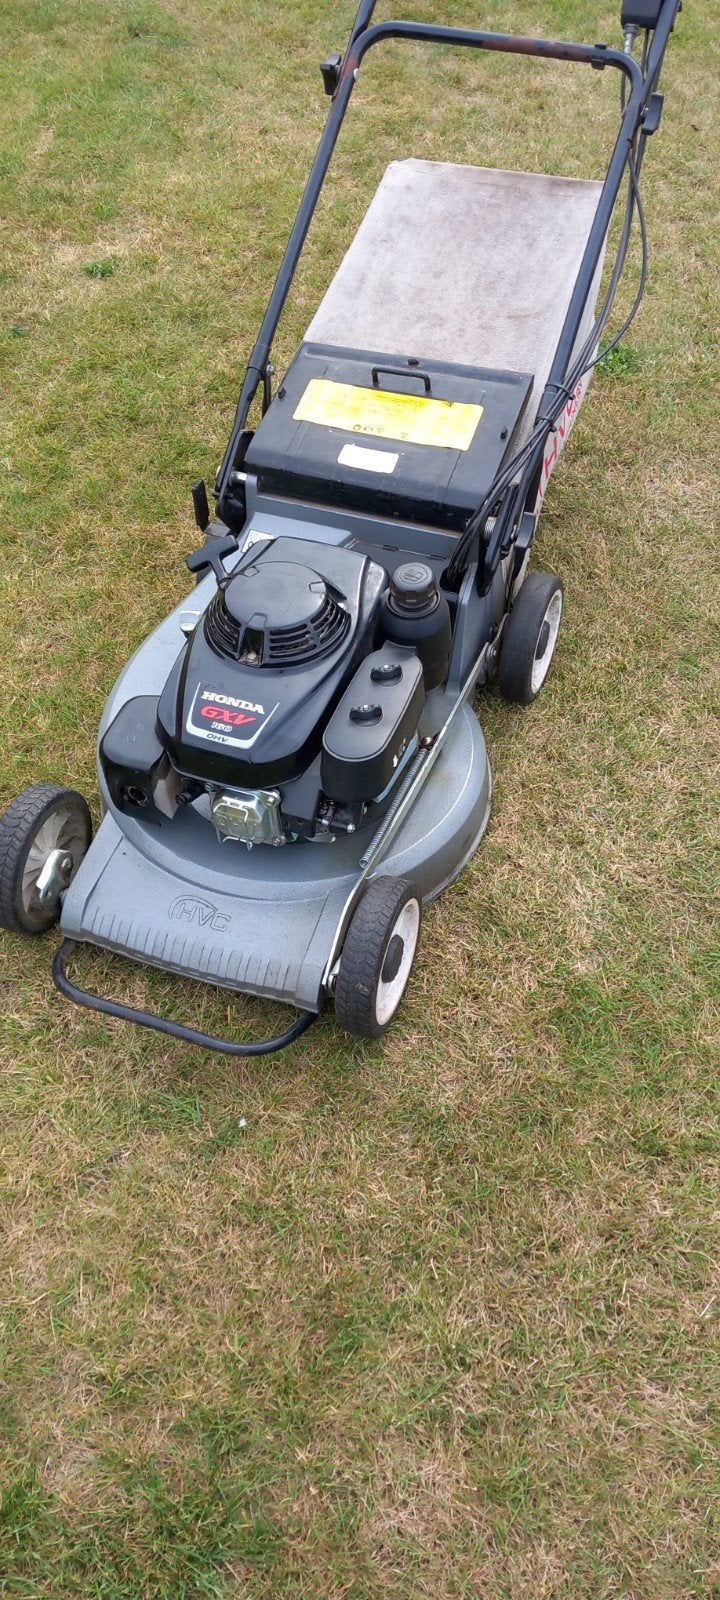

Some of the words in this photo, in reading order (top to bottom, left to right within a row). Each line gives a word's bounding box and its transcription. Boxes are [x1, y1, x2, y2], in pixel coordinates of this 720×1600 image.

[200, 690, 265, 715] HONDA
[200, 705, 257, 727] GXV
[211, 721, 233, 733] 160
[206, 733, 229, 743] OHV
[176, 902, 232, 932] HVC
